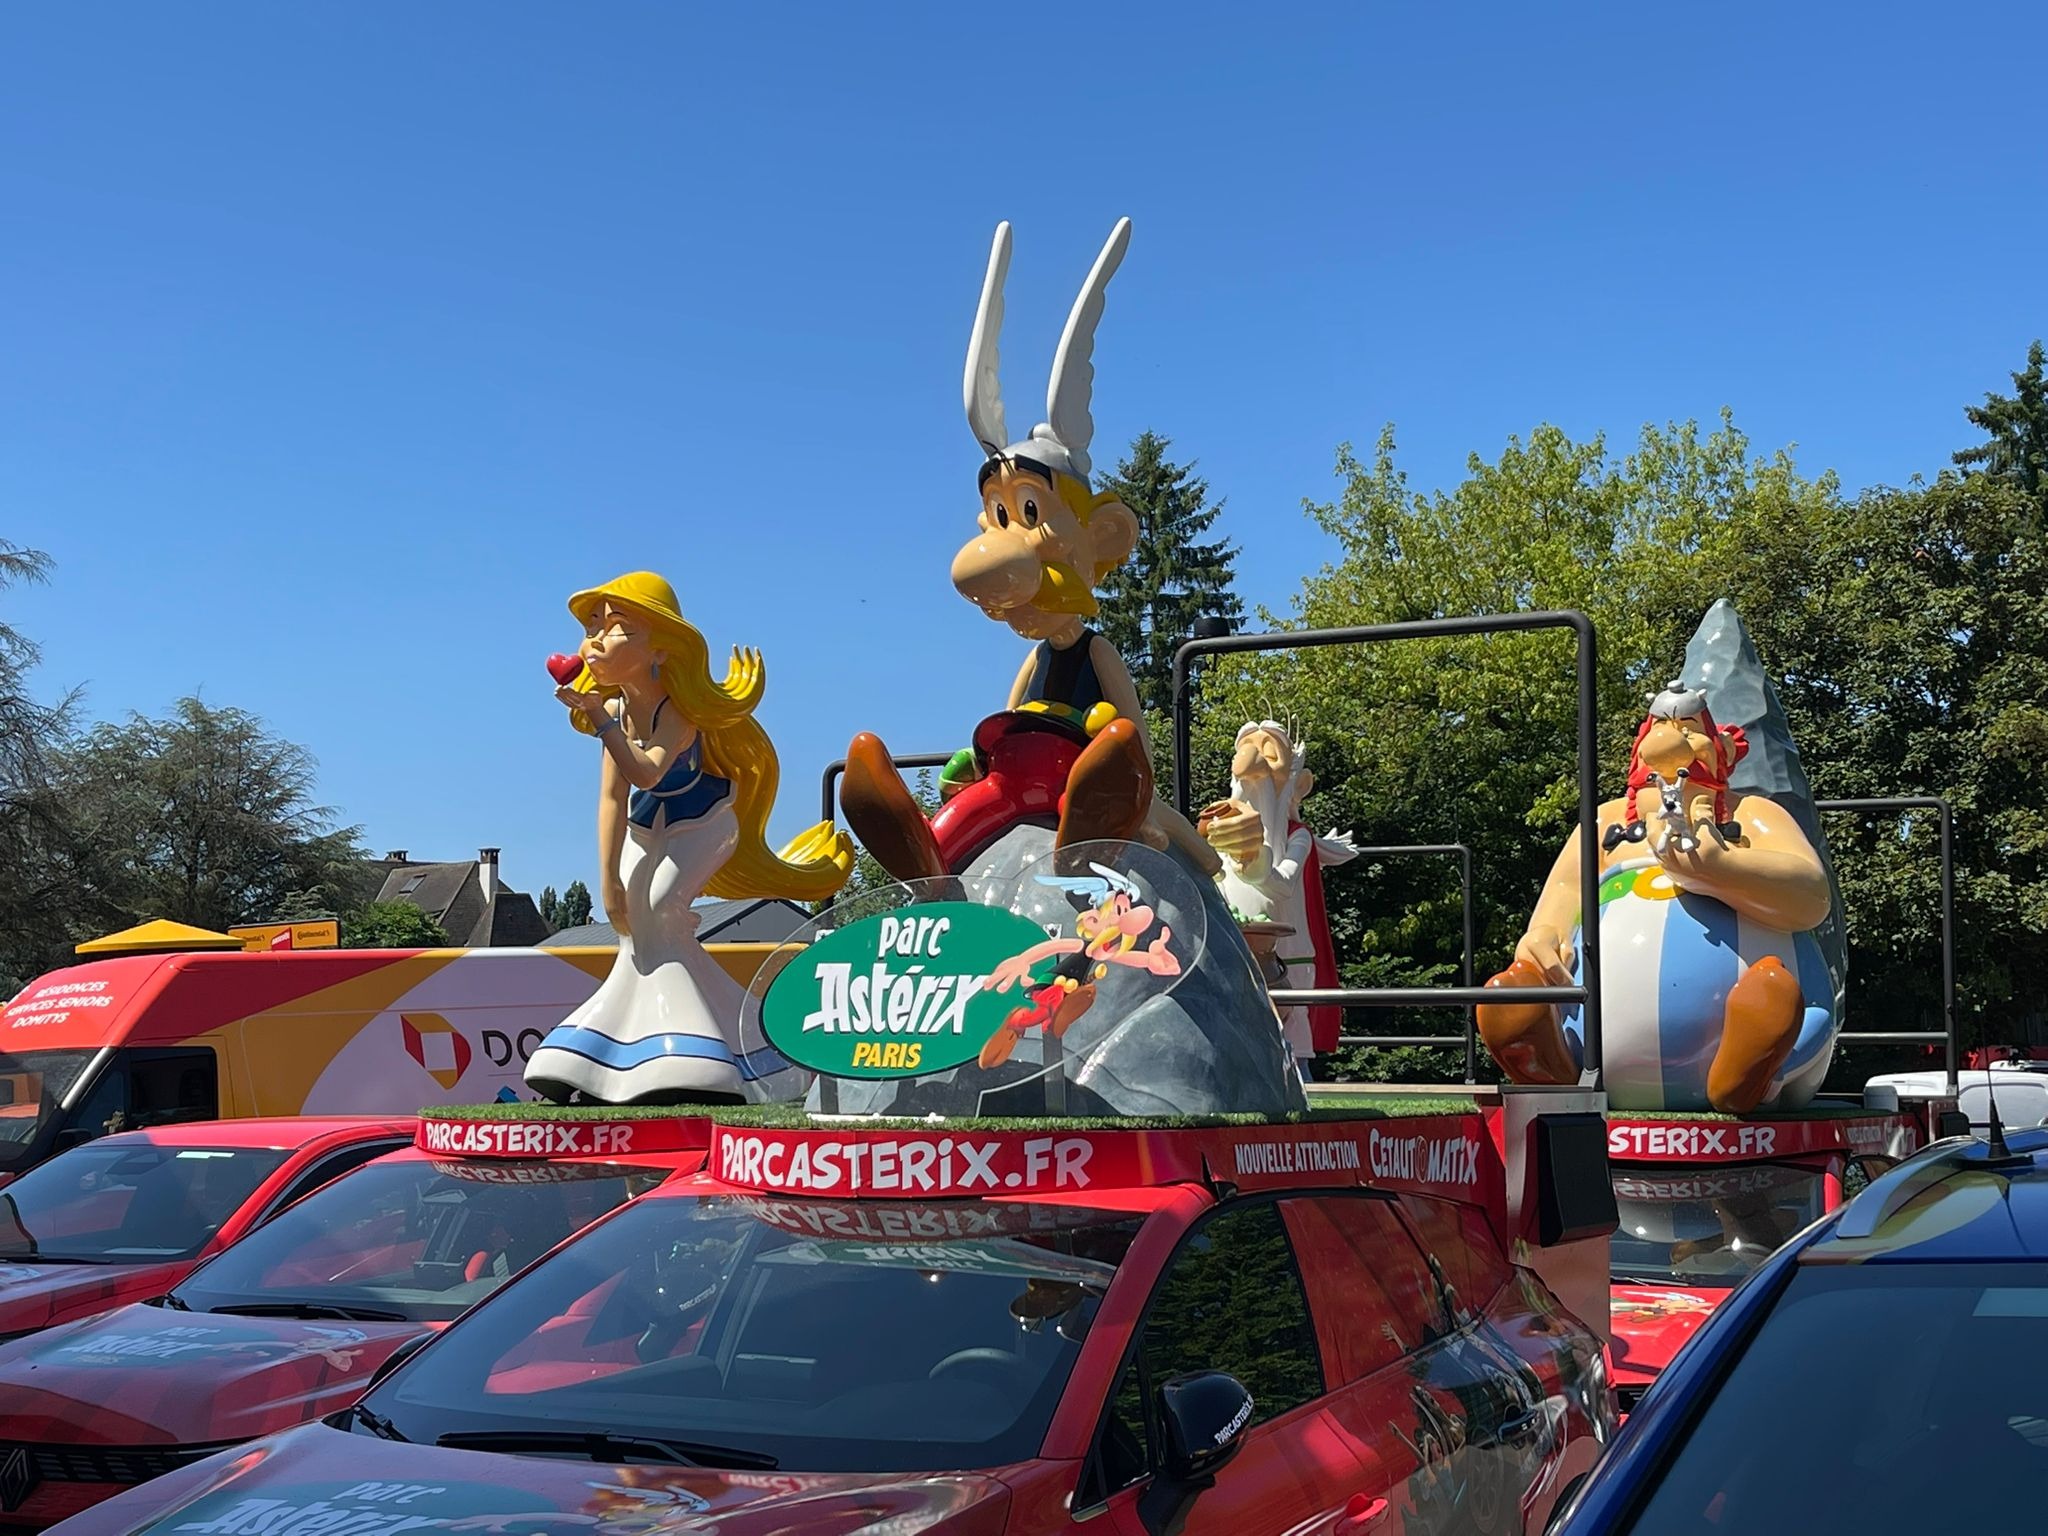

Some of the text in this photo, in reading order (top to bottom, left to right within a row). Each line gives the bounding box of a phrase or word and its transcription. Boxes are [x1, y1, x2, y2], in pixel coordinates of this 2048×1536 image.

[878, 917, 950, 958] parc
[55, 996, 113, 1009] SENIORS
[803, 962, 994, 1034] Astérix
[852, 1042, 921, 1068] PARIS
[1234, 1140, 1360, 1175] NOUVELLE ATTRACTION
